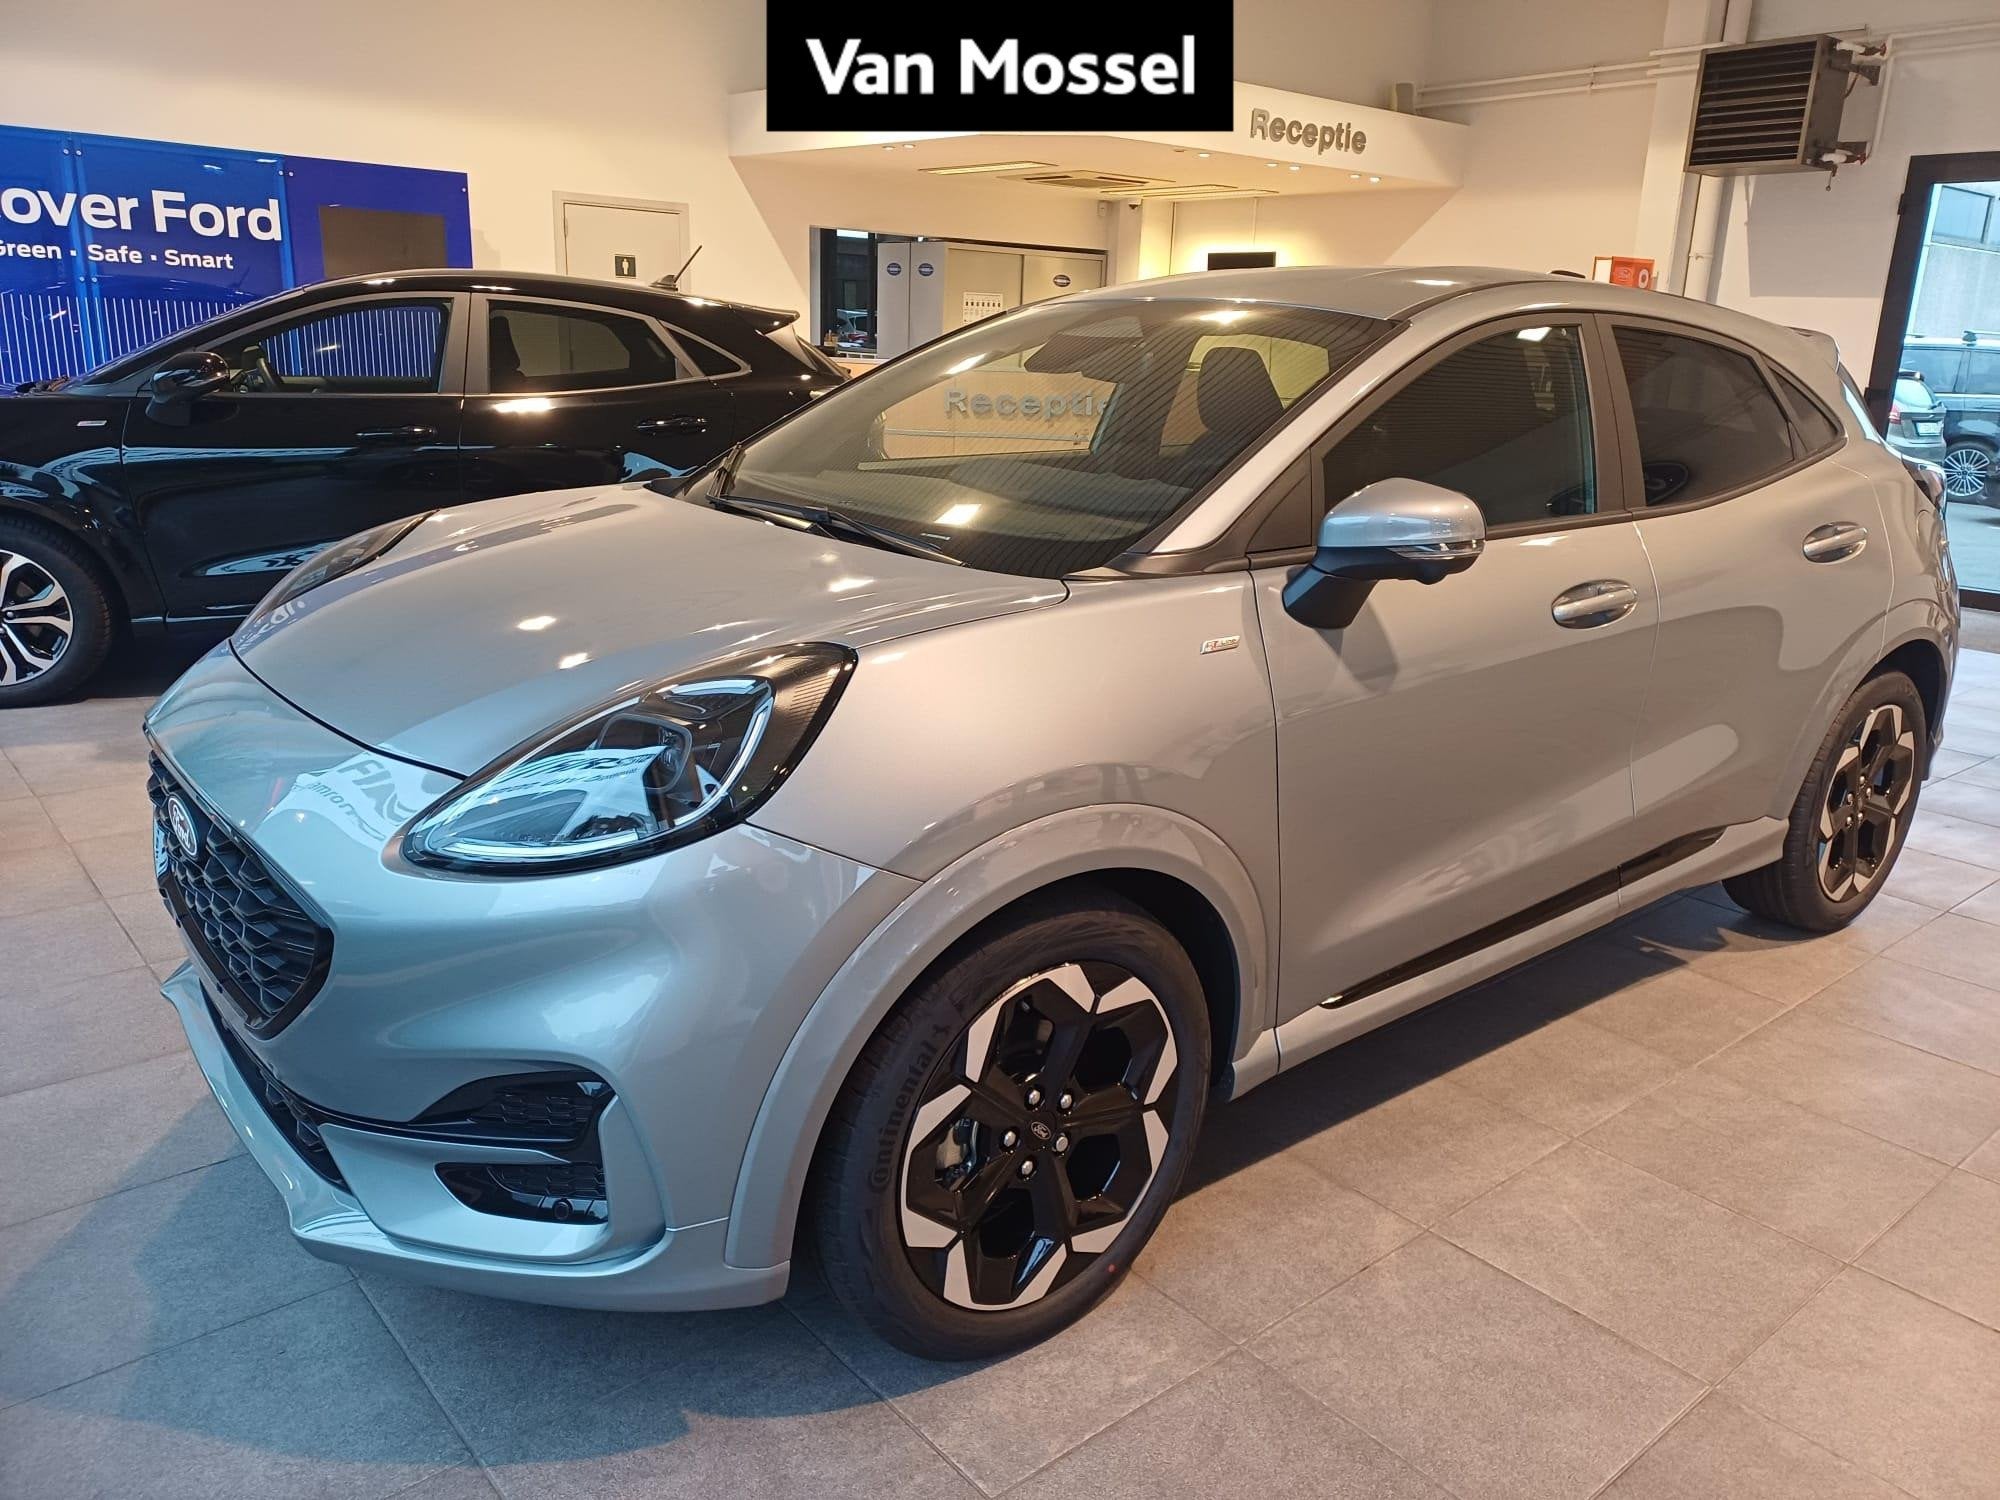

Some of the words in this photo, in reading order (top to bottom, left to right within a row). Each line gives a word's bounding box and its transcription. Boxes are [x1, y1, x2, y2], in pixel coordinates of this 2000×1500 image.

[1249, 107, 1367, 155] Receptie
[0, 188, 139, 231] over
[151, 189, 282, 241] Ford
[87, 244, 143, 264] Safe
[164, 249, 234, 270] Smart
[171, 802, 194, 851] Ford
[870, 1040, 935, 1190] Continental
